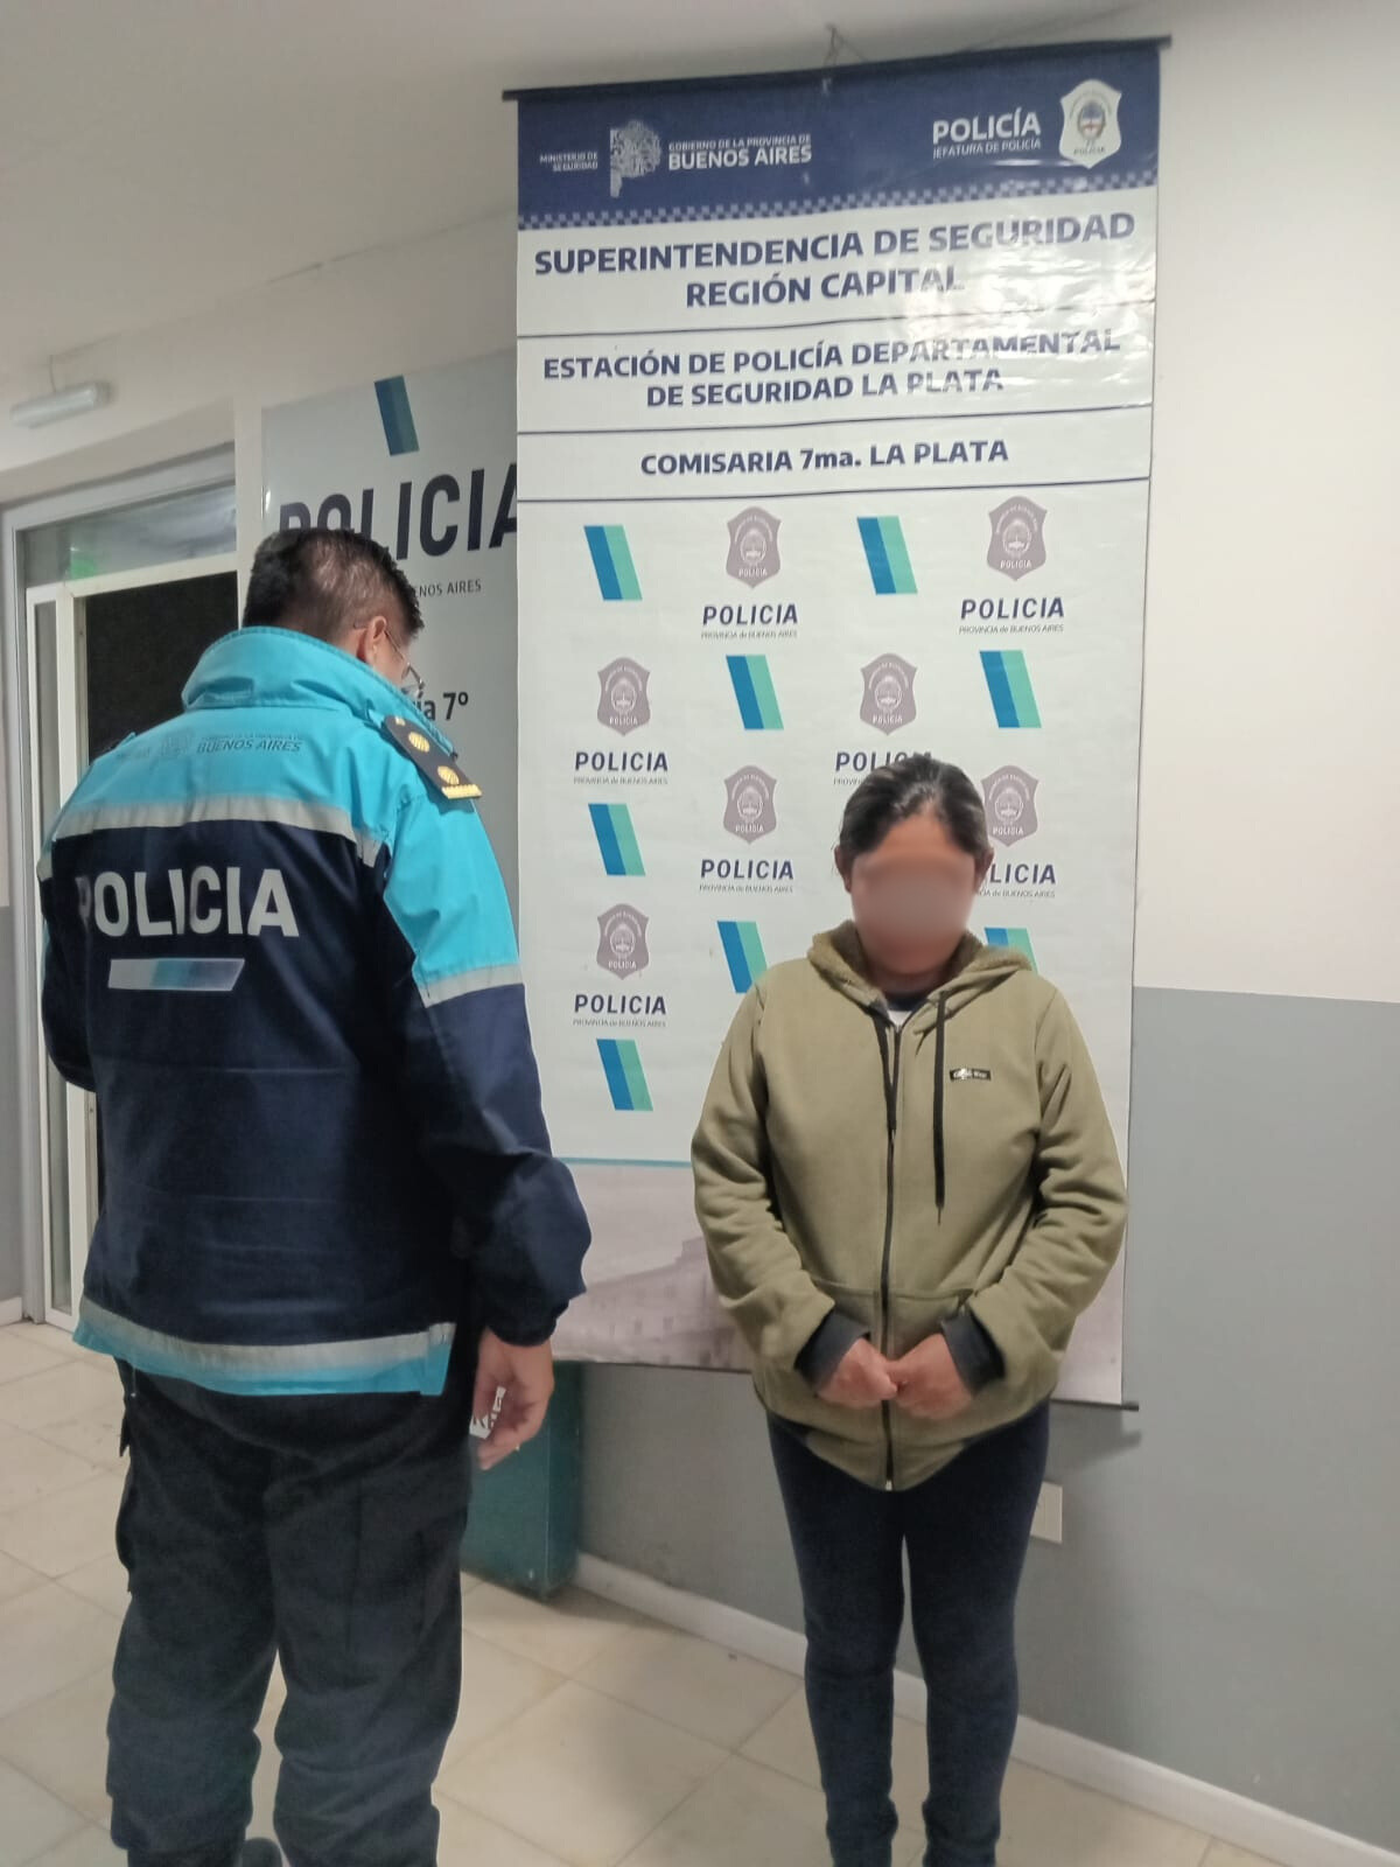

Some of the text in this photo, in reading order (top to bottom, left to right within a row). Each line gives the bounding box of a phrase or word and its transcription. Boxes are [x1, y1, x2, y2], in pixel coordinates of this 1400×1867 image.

[932, 106, 1041, 145] POLICÍA
[668, 145, 813, 171] BUENOS AIRES
[534, 212, 1135, 275] SUPERINTENDENCIA DE SEGURIDAD
[686, 266, 966, 308] REGIÓN CAPITAL
[543, 329, 1121, 379] ESTACIÓN DE POLICÍA DEPARTAMENTAL
[647, 367, 1004, 407] DE SEGURIDAD LA PLATA
[641, 439, 1009, 475] COMISARIA 7ma. LA PLATA
[414, 579, 482, 598] ENOS AIRES
[702, 604, 798, 626] POLICIA
[960, 597, 1064, 620] POLICIA
[255, 740, 302, 753] AIRES
[574, 752, 668, 771] POLICIA
[835, 751, 931, 772] POLI
[700, 859, 794, 880] POLICIA
[988, 863, 1057, 885] LICIA
[75, 865, 300, 938] POLICIA
[574, 994, 667, 1015] POLICIA
